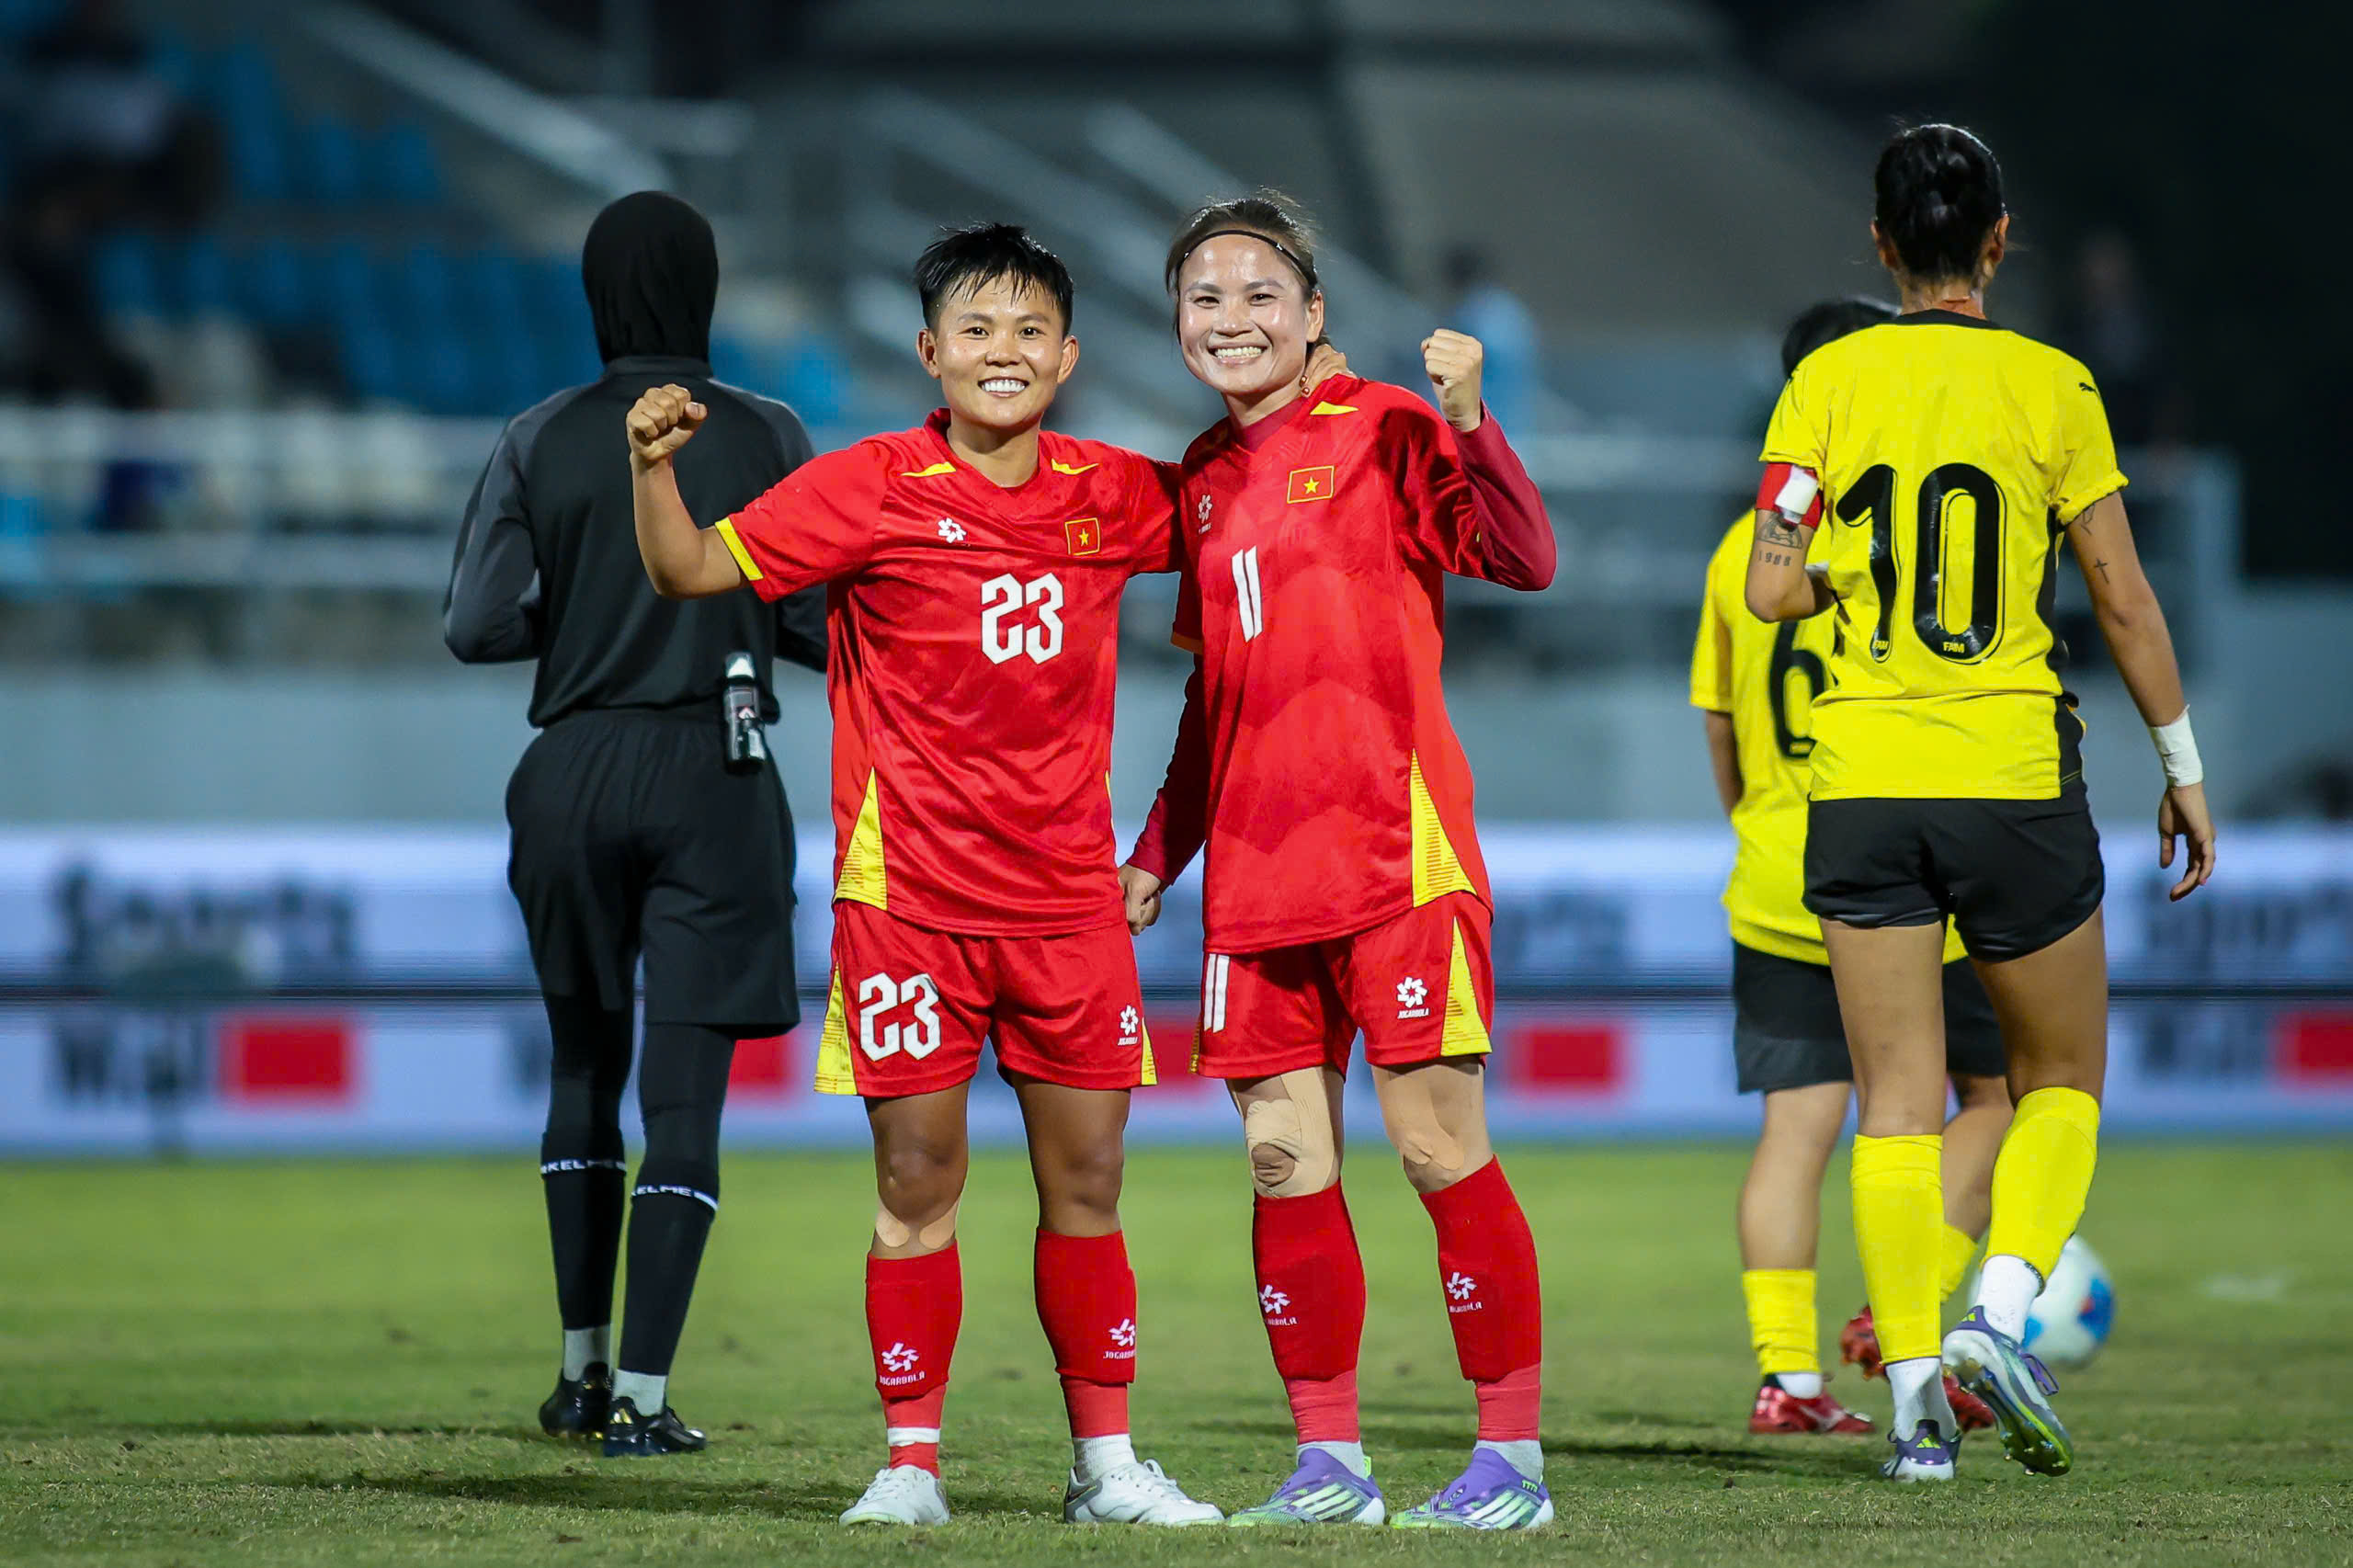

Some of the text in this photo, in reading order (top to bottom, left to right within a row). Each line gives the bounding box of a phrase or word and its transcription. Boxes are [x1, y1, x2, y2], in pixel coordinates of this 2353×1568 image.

[1231, 544, 1263, 643] 11
[1836, 462, 2006, 665] 10
[980, 571, 1064, 665] 23
[1769, 619, 1825, 760] 6
[858, 971, 941, 1062] 23
[1203, 953, 1230, 1034] 11
